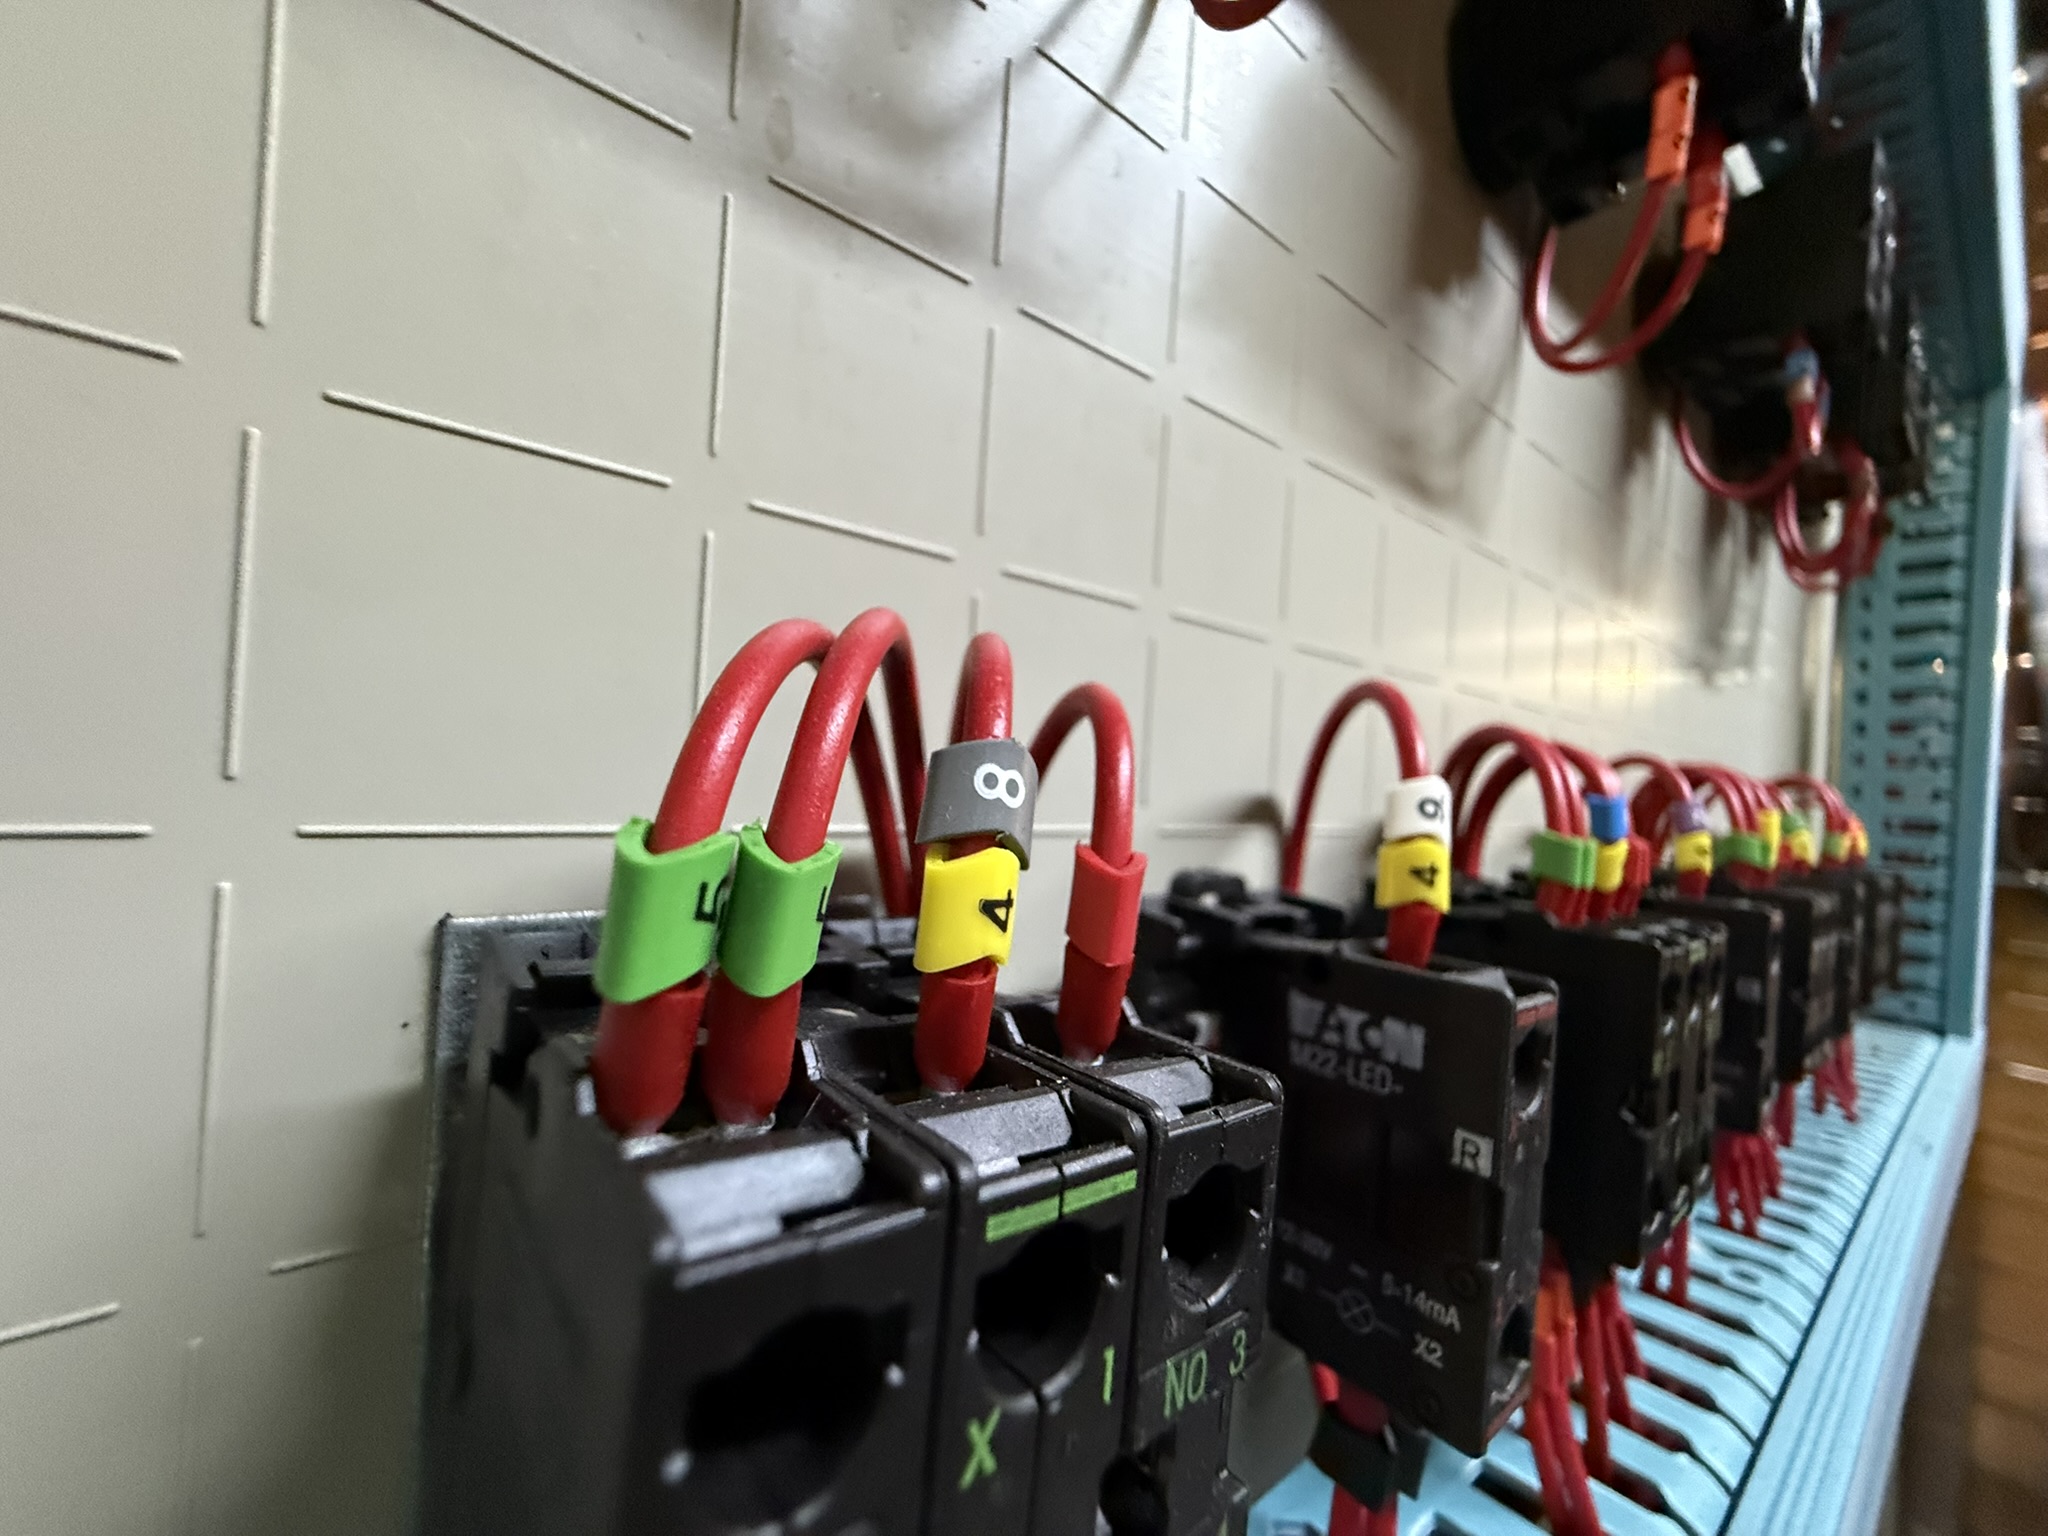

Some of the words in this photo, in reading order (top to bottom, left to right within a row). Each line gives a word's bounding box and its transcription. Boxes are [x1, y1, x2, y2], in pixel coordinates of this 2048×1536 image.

[974, 763, 1025, 808] 8
[1409, 862, 1438, 888] 4
[979, 888, 1014, 933] 4
[1461, 1137, 1487, 1172] R
[1413, 1332, 1444, 1369] X2
[1163, 1348, 1207, 1419] NO
[1229, 1328, 1247, 1376] 3
[959, 1403, 1001, 1490] X
